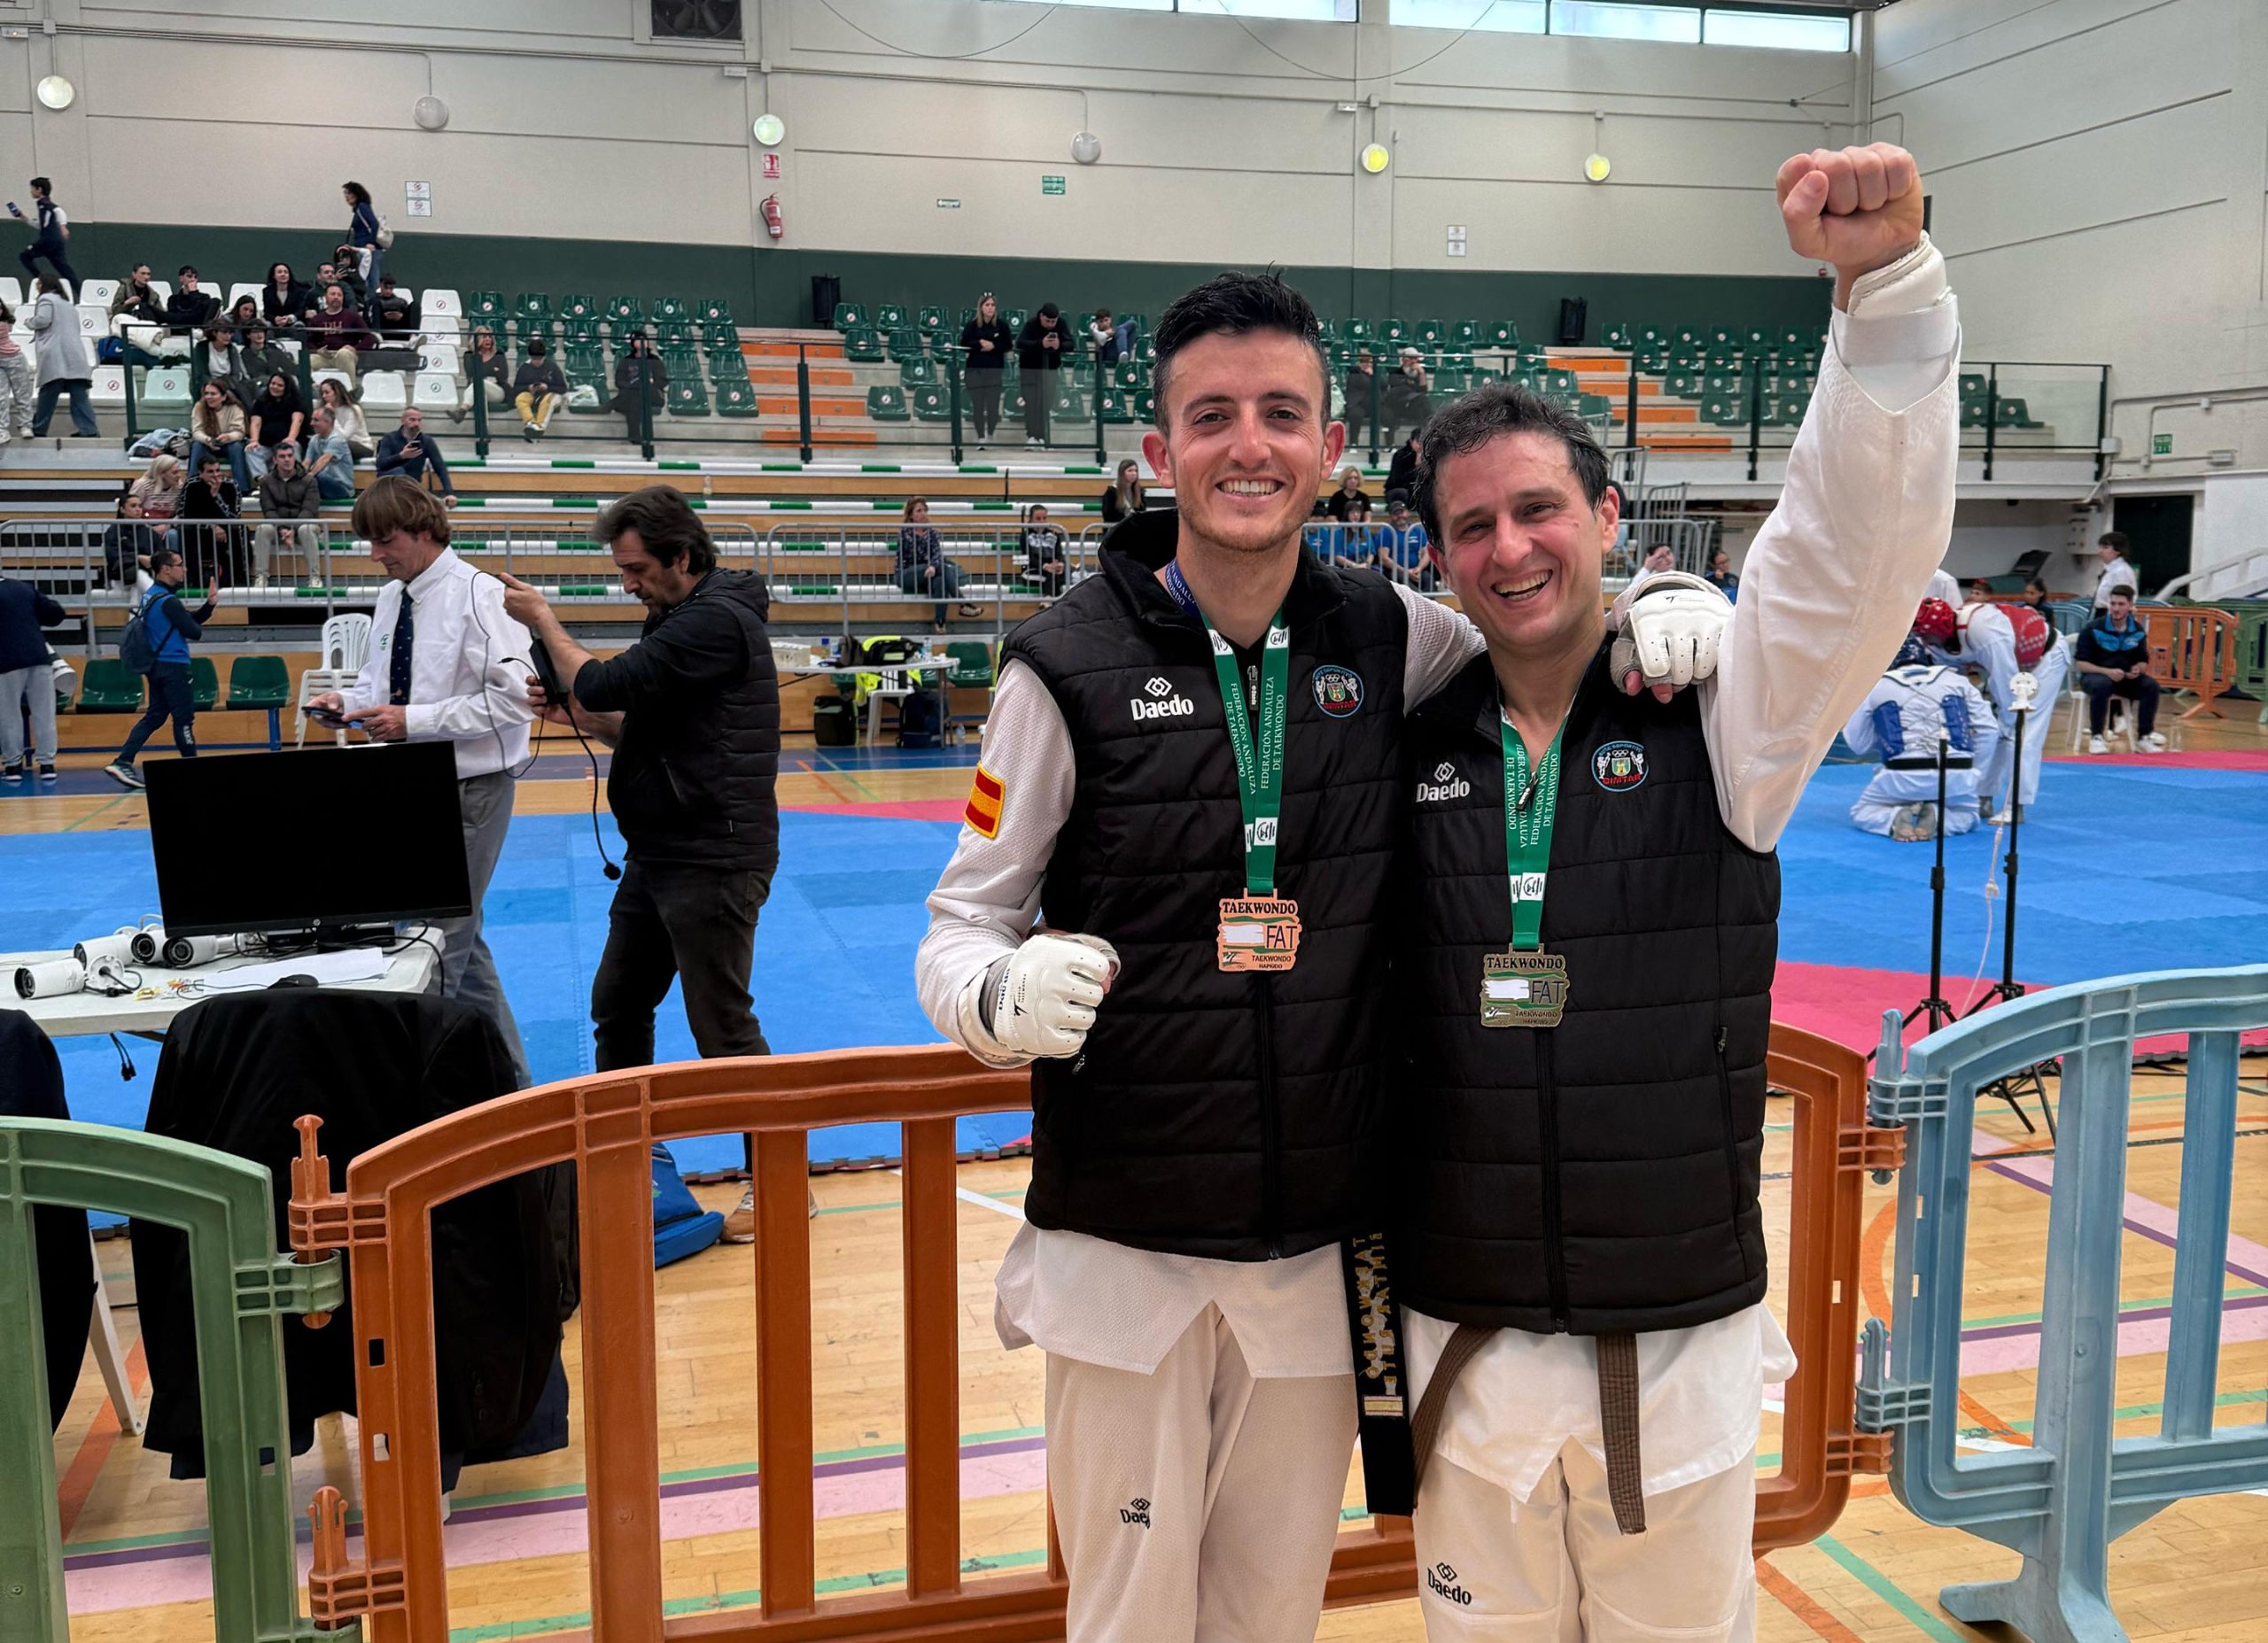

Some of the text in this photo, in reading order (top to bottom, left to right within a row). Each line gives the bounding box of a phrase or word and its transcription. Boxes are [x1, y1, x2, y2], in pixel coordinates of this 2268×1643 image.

[1130, 694, 1194, 721] Daedo
[1264, 677, 1274, 729] ANDALUZA
[1226, 701, 1245, 778] DE TAEKWONDO
[1272, 694, 1285, 771] DE TAEKWONDO
[1243, 742, 1256, 794] ANDALUZA
[1540, 748, 1551, 786] ANDAL
[1416, 777, 1471, 802] Daedo
[1507, 757, 1517, 830] DE TAEKWONDO
[1543, 754, 1558, 826] DE TAEKWONDO
[1223, 902, 1296, 914] TAEKWONDO
[1266, 925, 1298, 949] FAT
[1487, 957, 1563, 969] TAEKWONDO
[1531, 980, 1565, 1004] FAT
[1427, 1567, 1472, 1606] Daedo
